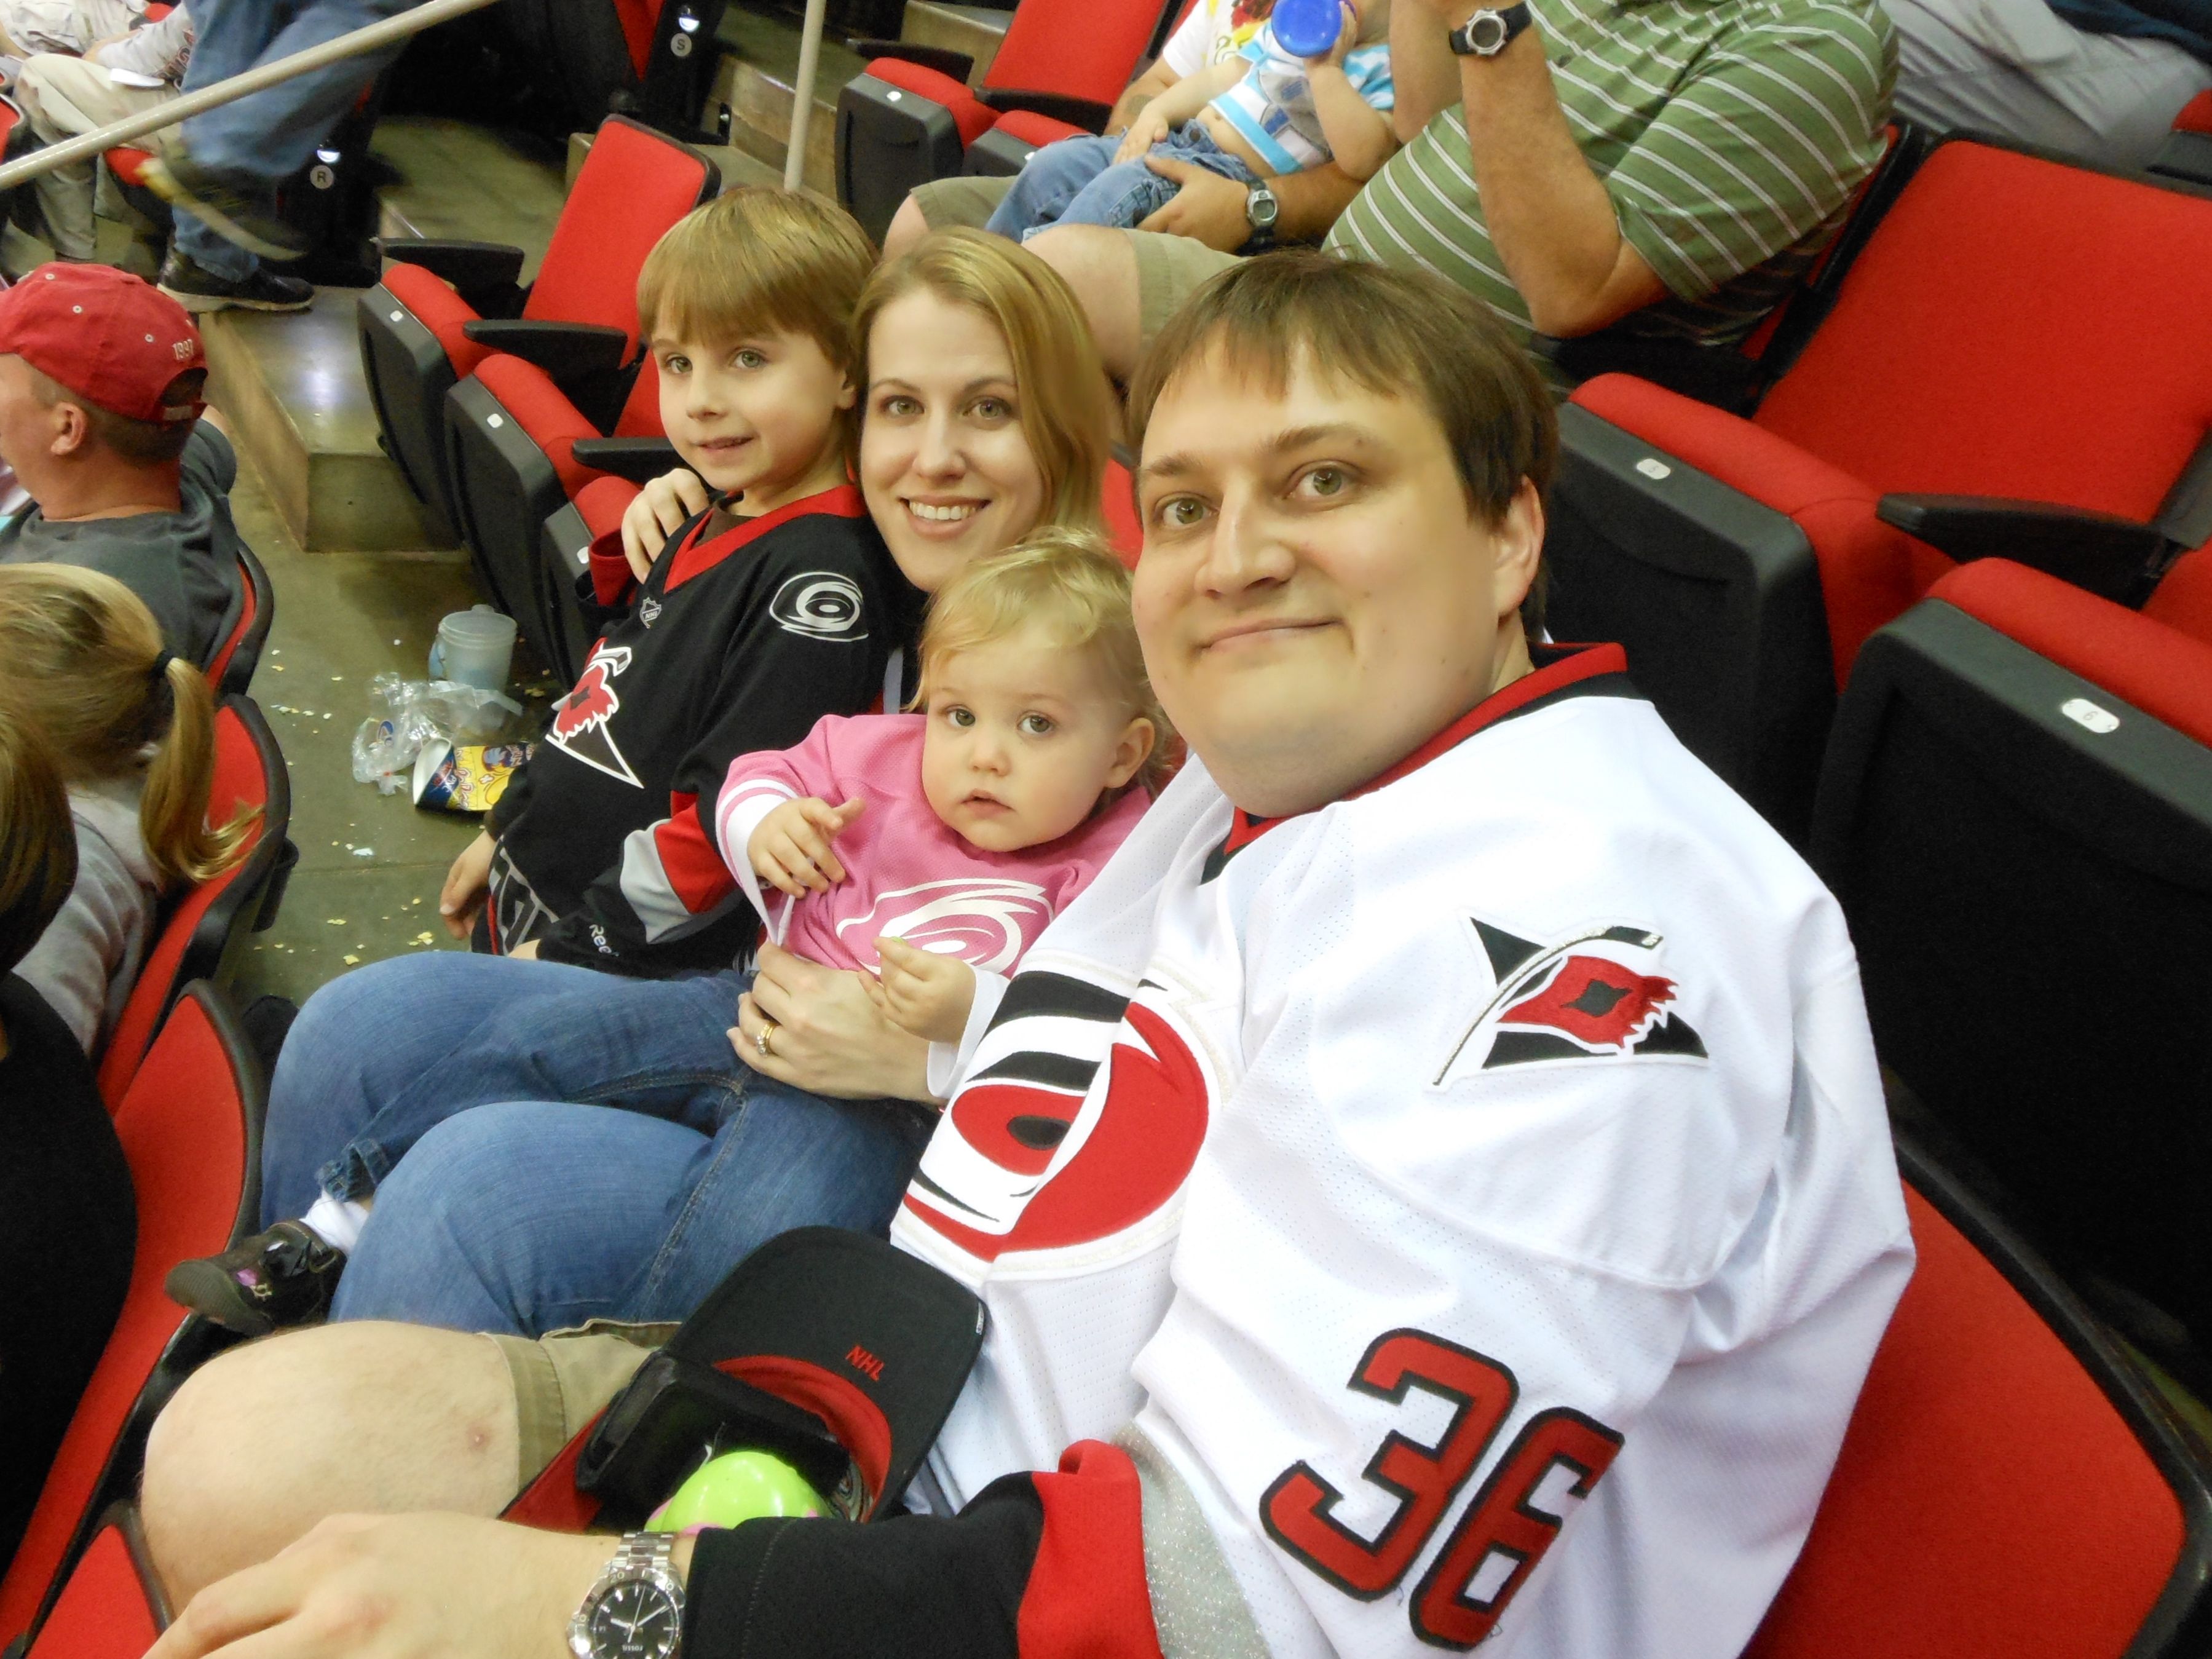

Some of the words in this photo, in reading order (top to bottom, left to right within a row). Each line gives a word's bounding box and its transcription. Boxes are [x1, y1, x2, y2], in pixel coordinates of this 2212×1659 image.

[677, 39, 685, 50] S
[317, 171, 326, 183] R
[845, 1345, 884, 1382] NHL
[1260, 1328, 1625, 1653] 36
